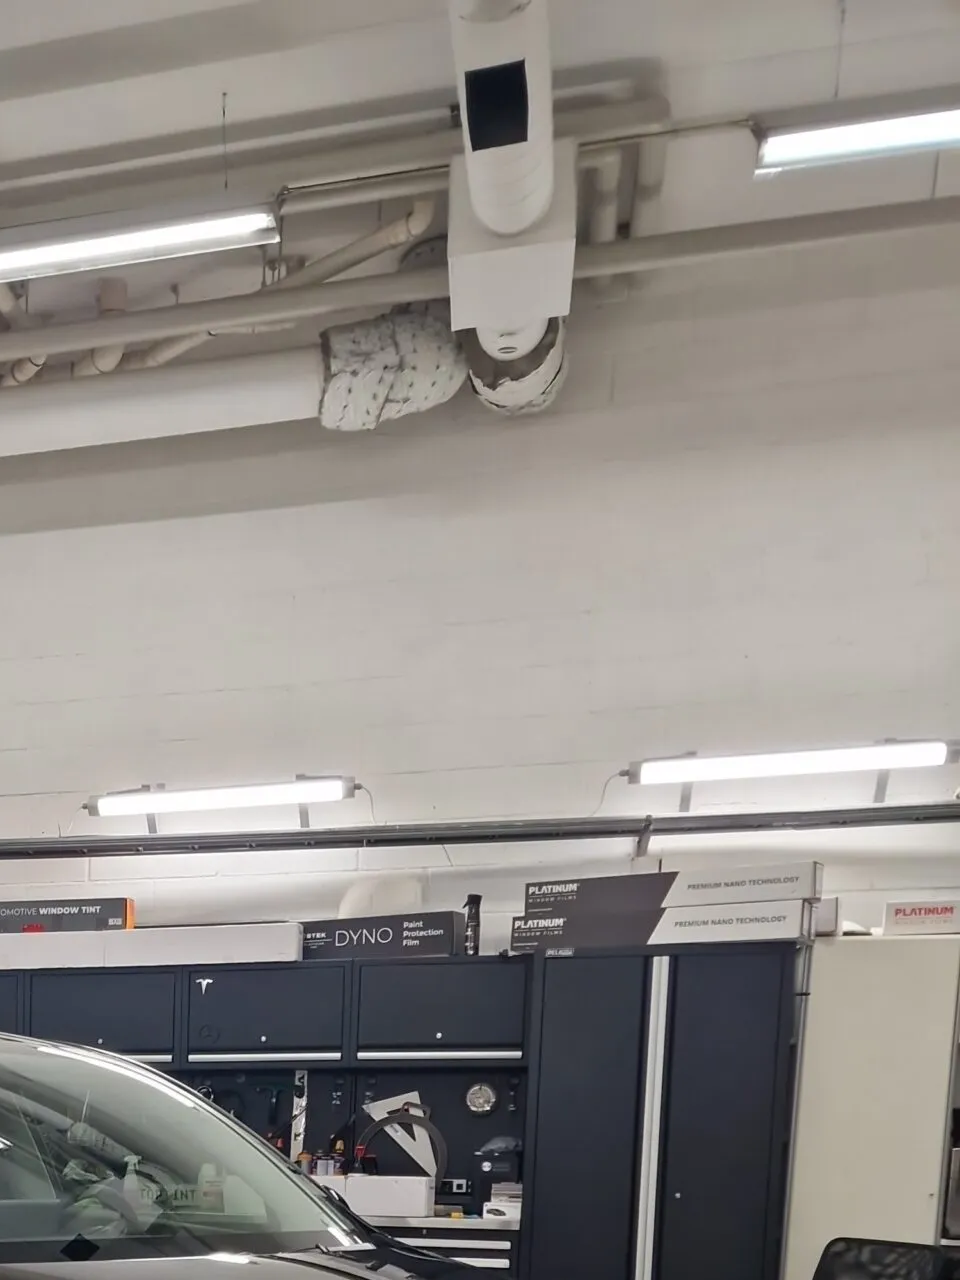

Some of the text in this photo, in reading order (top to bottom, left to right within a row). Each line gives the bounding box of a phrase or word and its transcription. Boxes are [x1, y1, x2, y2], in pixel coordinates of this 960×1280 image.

[687, 876, 799, 890] PREMIUM NANO TECHNOLOGY
[528, 883, 577, 895] PLATINUM
[39, 906, 79, 915] WINDOW
[81, 905, 101, 914] TINT
[894, 906, 954, 917] PLATINUM
[403, 920, 424, 929] Paint
[514, 918, 564, 929] PLATINUM
[674, 915, 787, 928] PREMIUM NANO TECHNOLOGY
[335, 927, 393, 947] DYNO
[403, 928, 444, 938] Protection
[402, 939, 420, 947] Film
